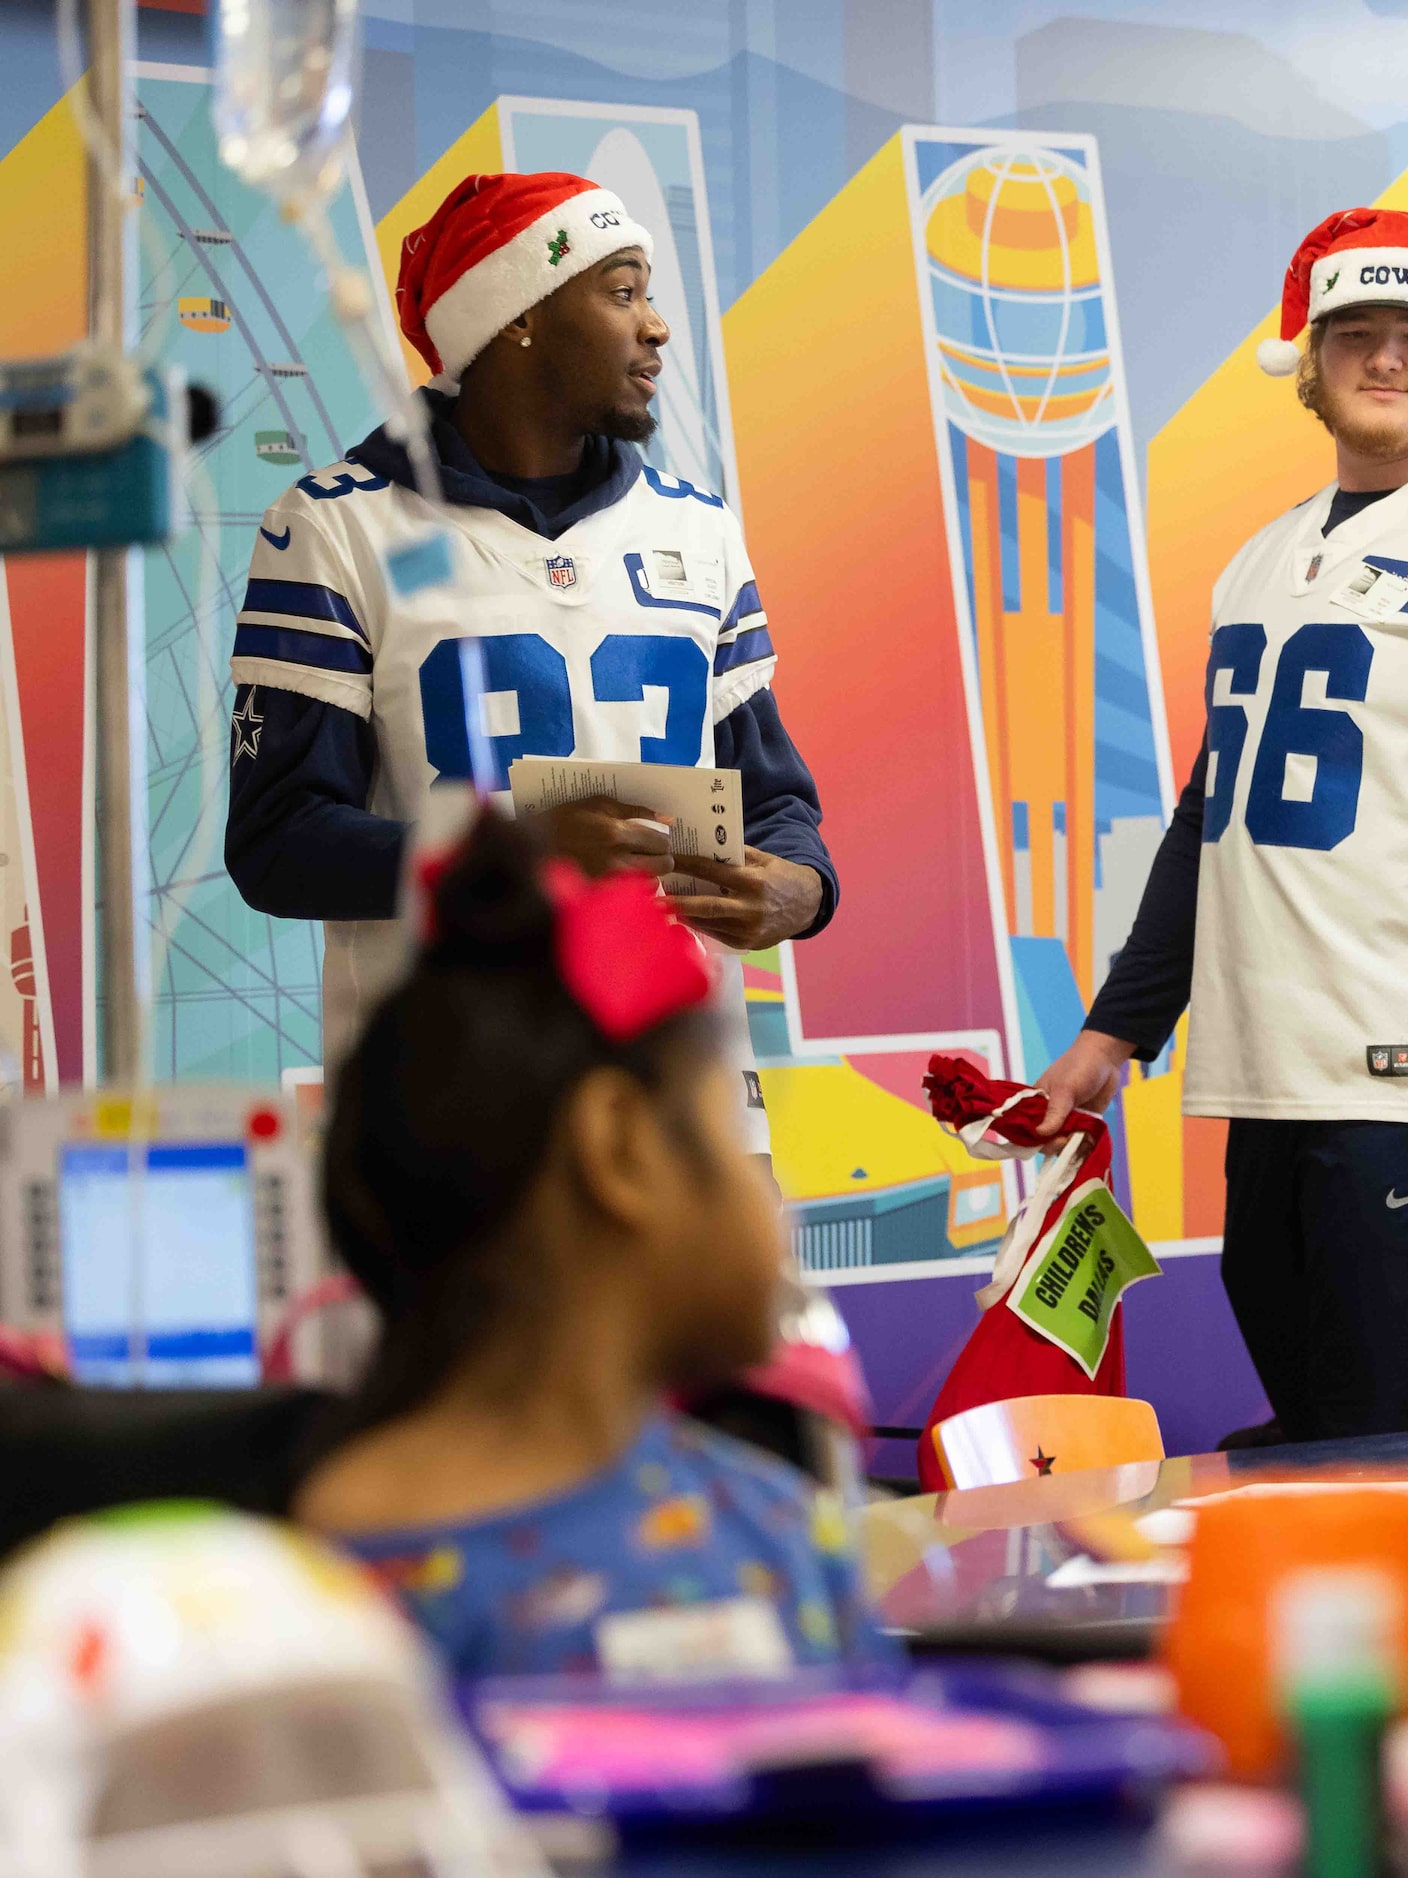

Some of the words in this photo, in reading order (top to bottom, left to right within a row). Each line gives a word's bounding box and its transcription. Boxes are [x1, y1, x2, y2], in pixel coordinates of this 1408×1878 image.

[551, 569, 574, 585] NFL
[1202, 622, 1375, 852] 66
[1035, 1203, 1106, 1309] CHILDRENS
